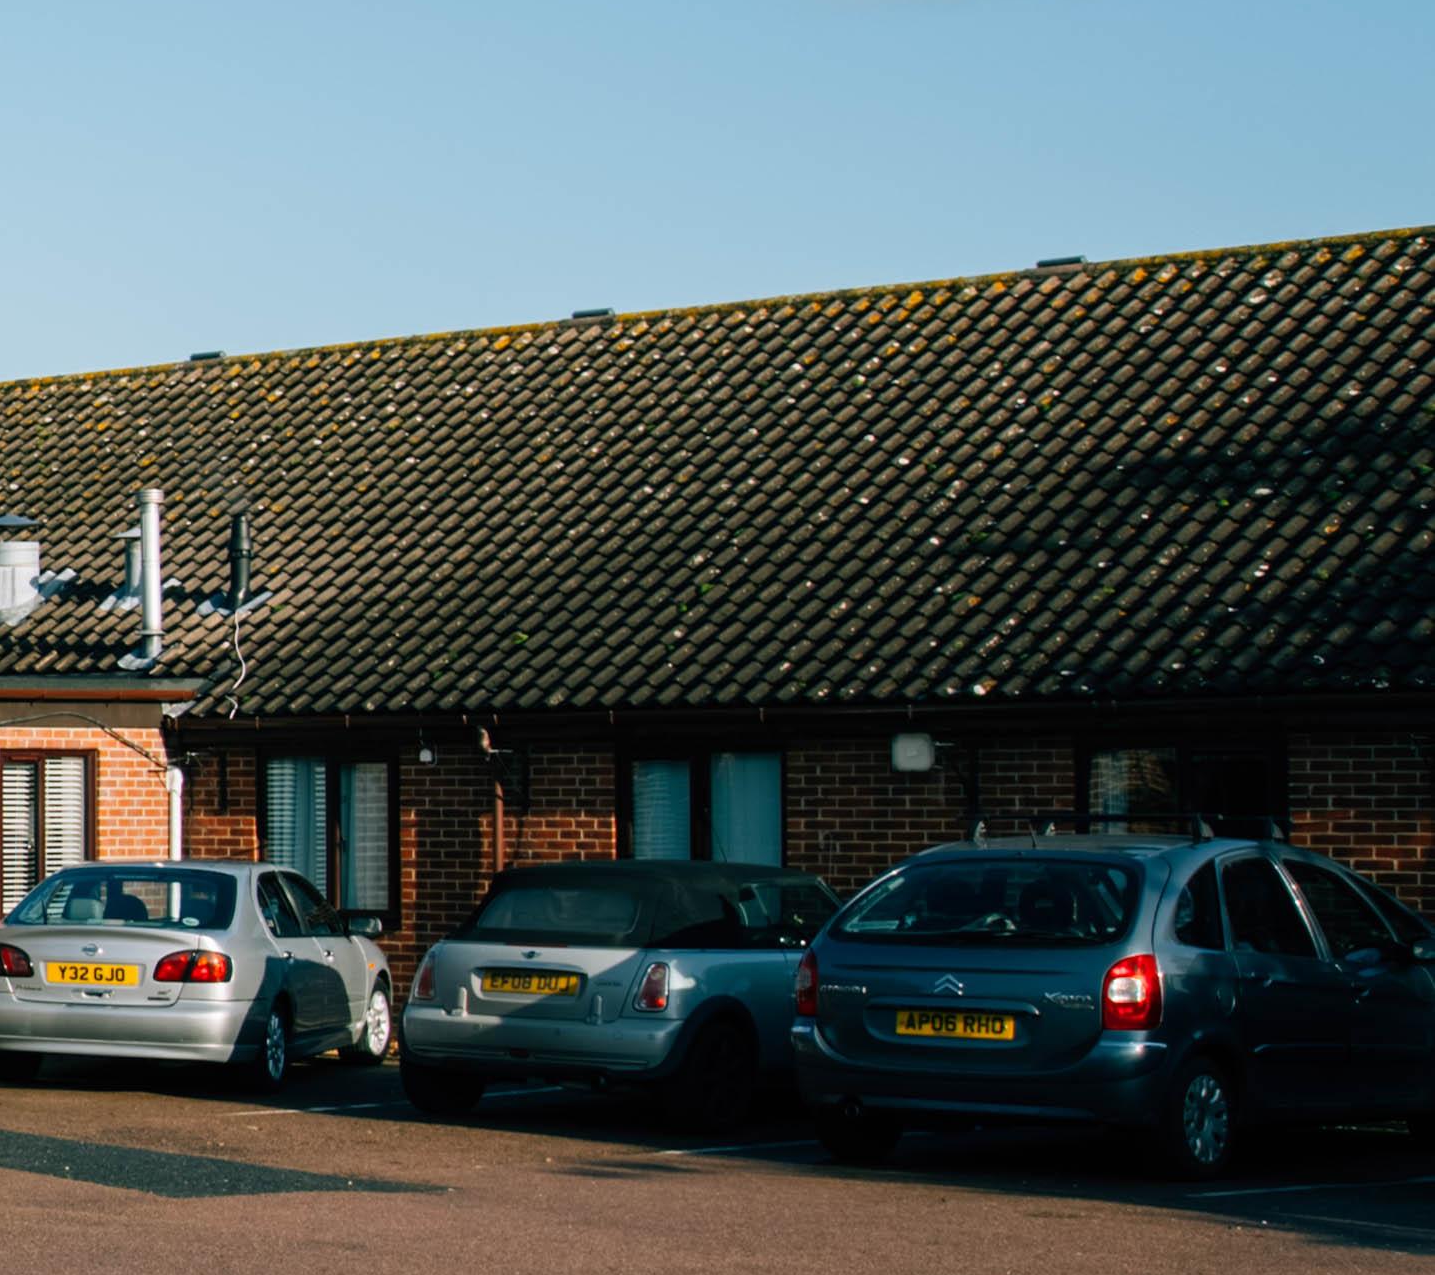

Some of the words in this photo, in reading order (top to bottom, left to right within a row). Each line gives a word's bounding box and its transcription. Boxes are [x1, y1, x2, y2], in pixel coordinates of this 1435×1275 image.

[58, 966, 90, 982] Y32
[94, 967, 125, 983] GJO
[904, 1011, 956, 1032] AP06
[963, 1014, 1005, 1035] RHO
